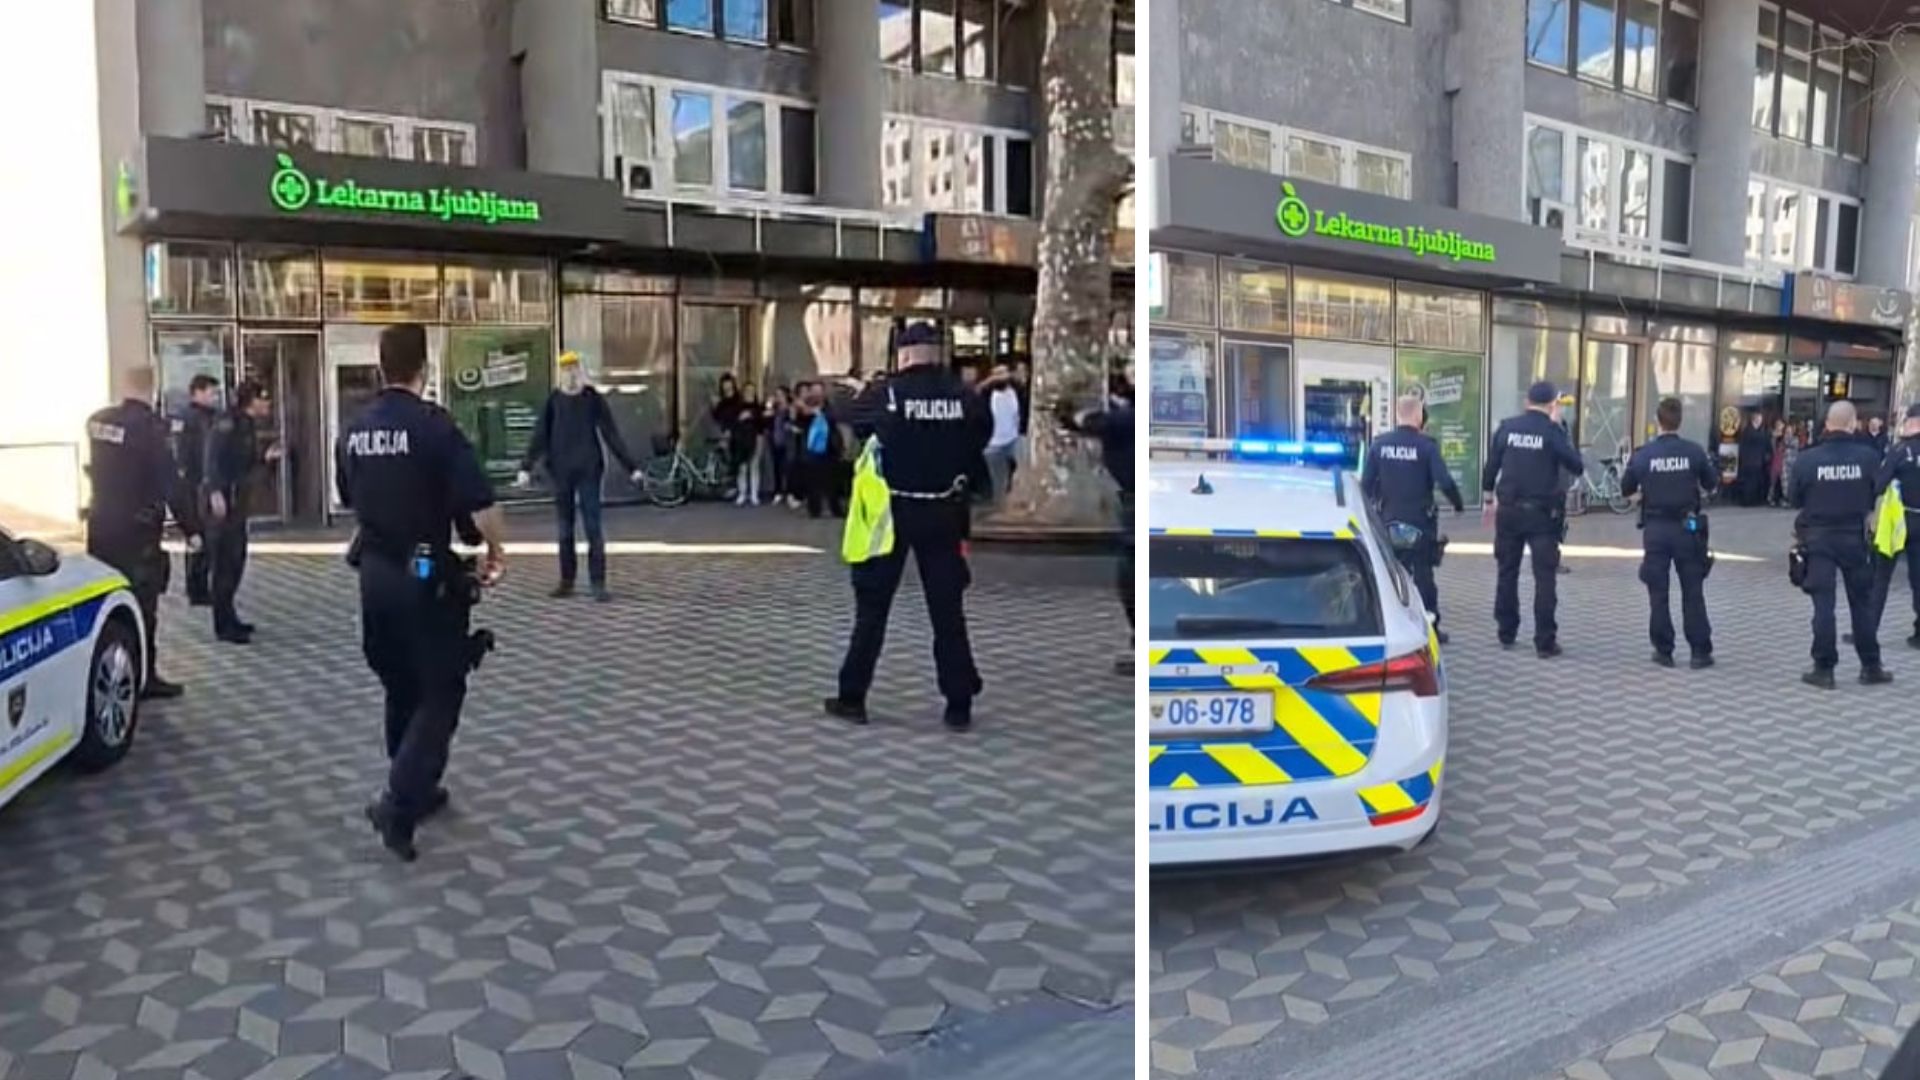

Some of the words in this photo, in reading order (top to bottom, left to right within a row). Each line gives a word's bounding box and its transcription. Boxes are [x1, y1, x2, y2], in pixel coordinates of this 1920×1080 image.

[316, 179, 425, 211] Lekarna
[428, 188, 540, 223] Ljubljana
[1314, 210, 1403, 246] Lekarna
[1406, 226, 1495, 262] Ljubljana
[904, 399, 963, 420] POLICIJA
[347, 429, 409, 456] POLICIJA
[1507, 432, 1543, 449] POLICIJA
[1381, 445, 1418, 461] POLICIJA
[1650, 457, 1690, 473] POLICIJA
[1818, 465, 1862, 481] POLICIJA
[0, 625, 54, 669] LICIJA
[1168, 697, 1255, 725] 06-978
